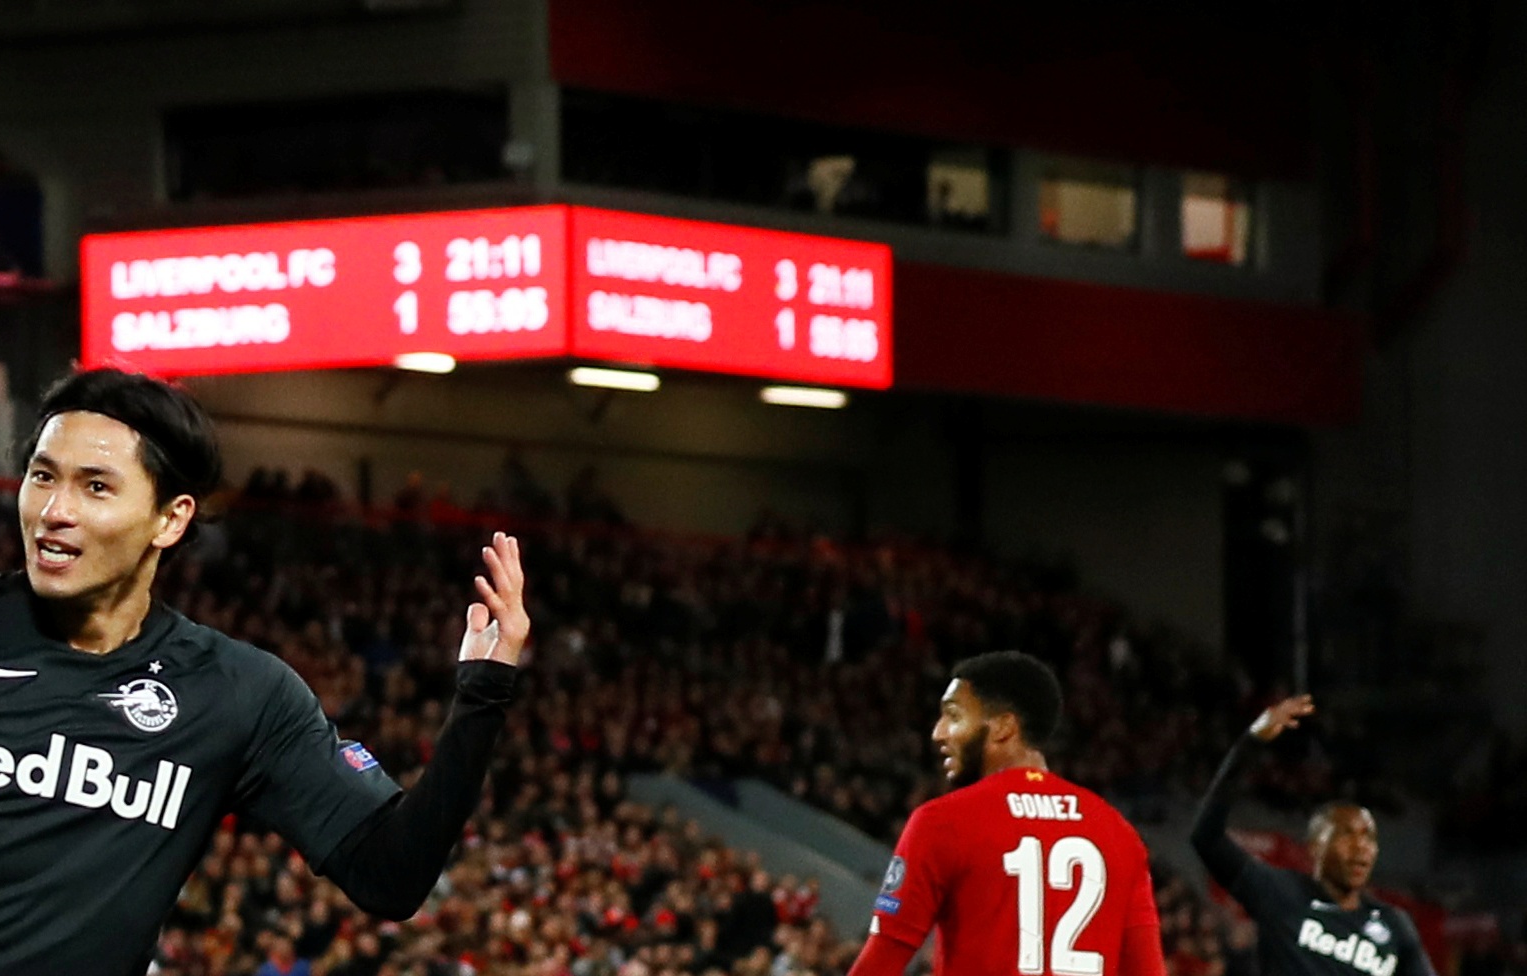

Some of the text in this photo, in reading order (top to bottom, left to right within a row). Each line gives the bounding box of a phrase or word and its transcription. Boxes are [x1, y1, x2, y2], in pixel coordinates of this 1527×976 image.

[111, 234, 541, 299] LIVERPOOL FC 3 21:11
[394, 290, 418, 334] 1
[776, 308, 795, 350] 1
[1006, 792, 1083, 821] GOMEZ
